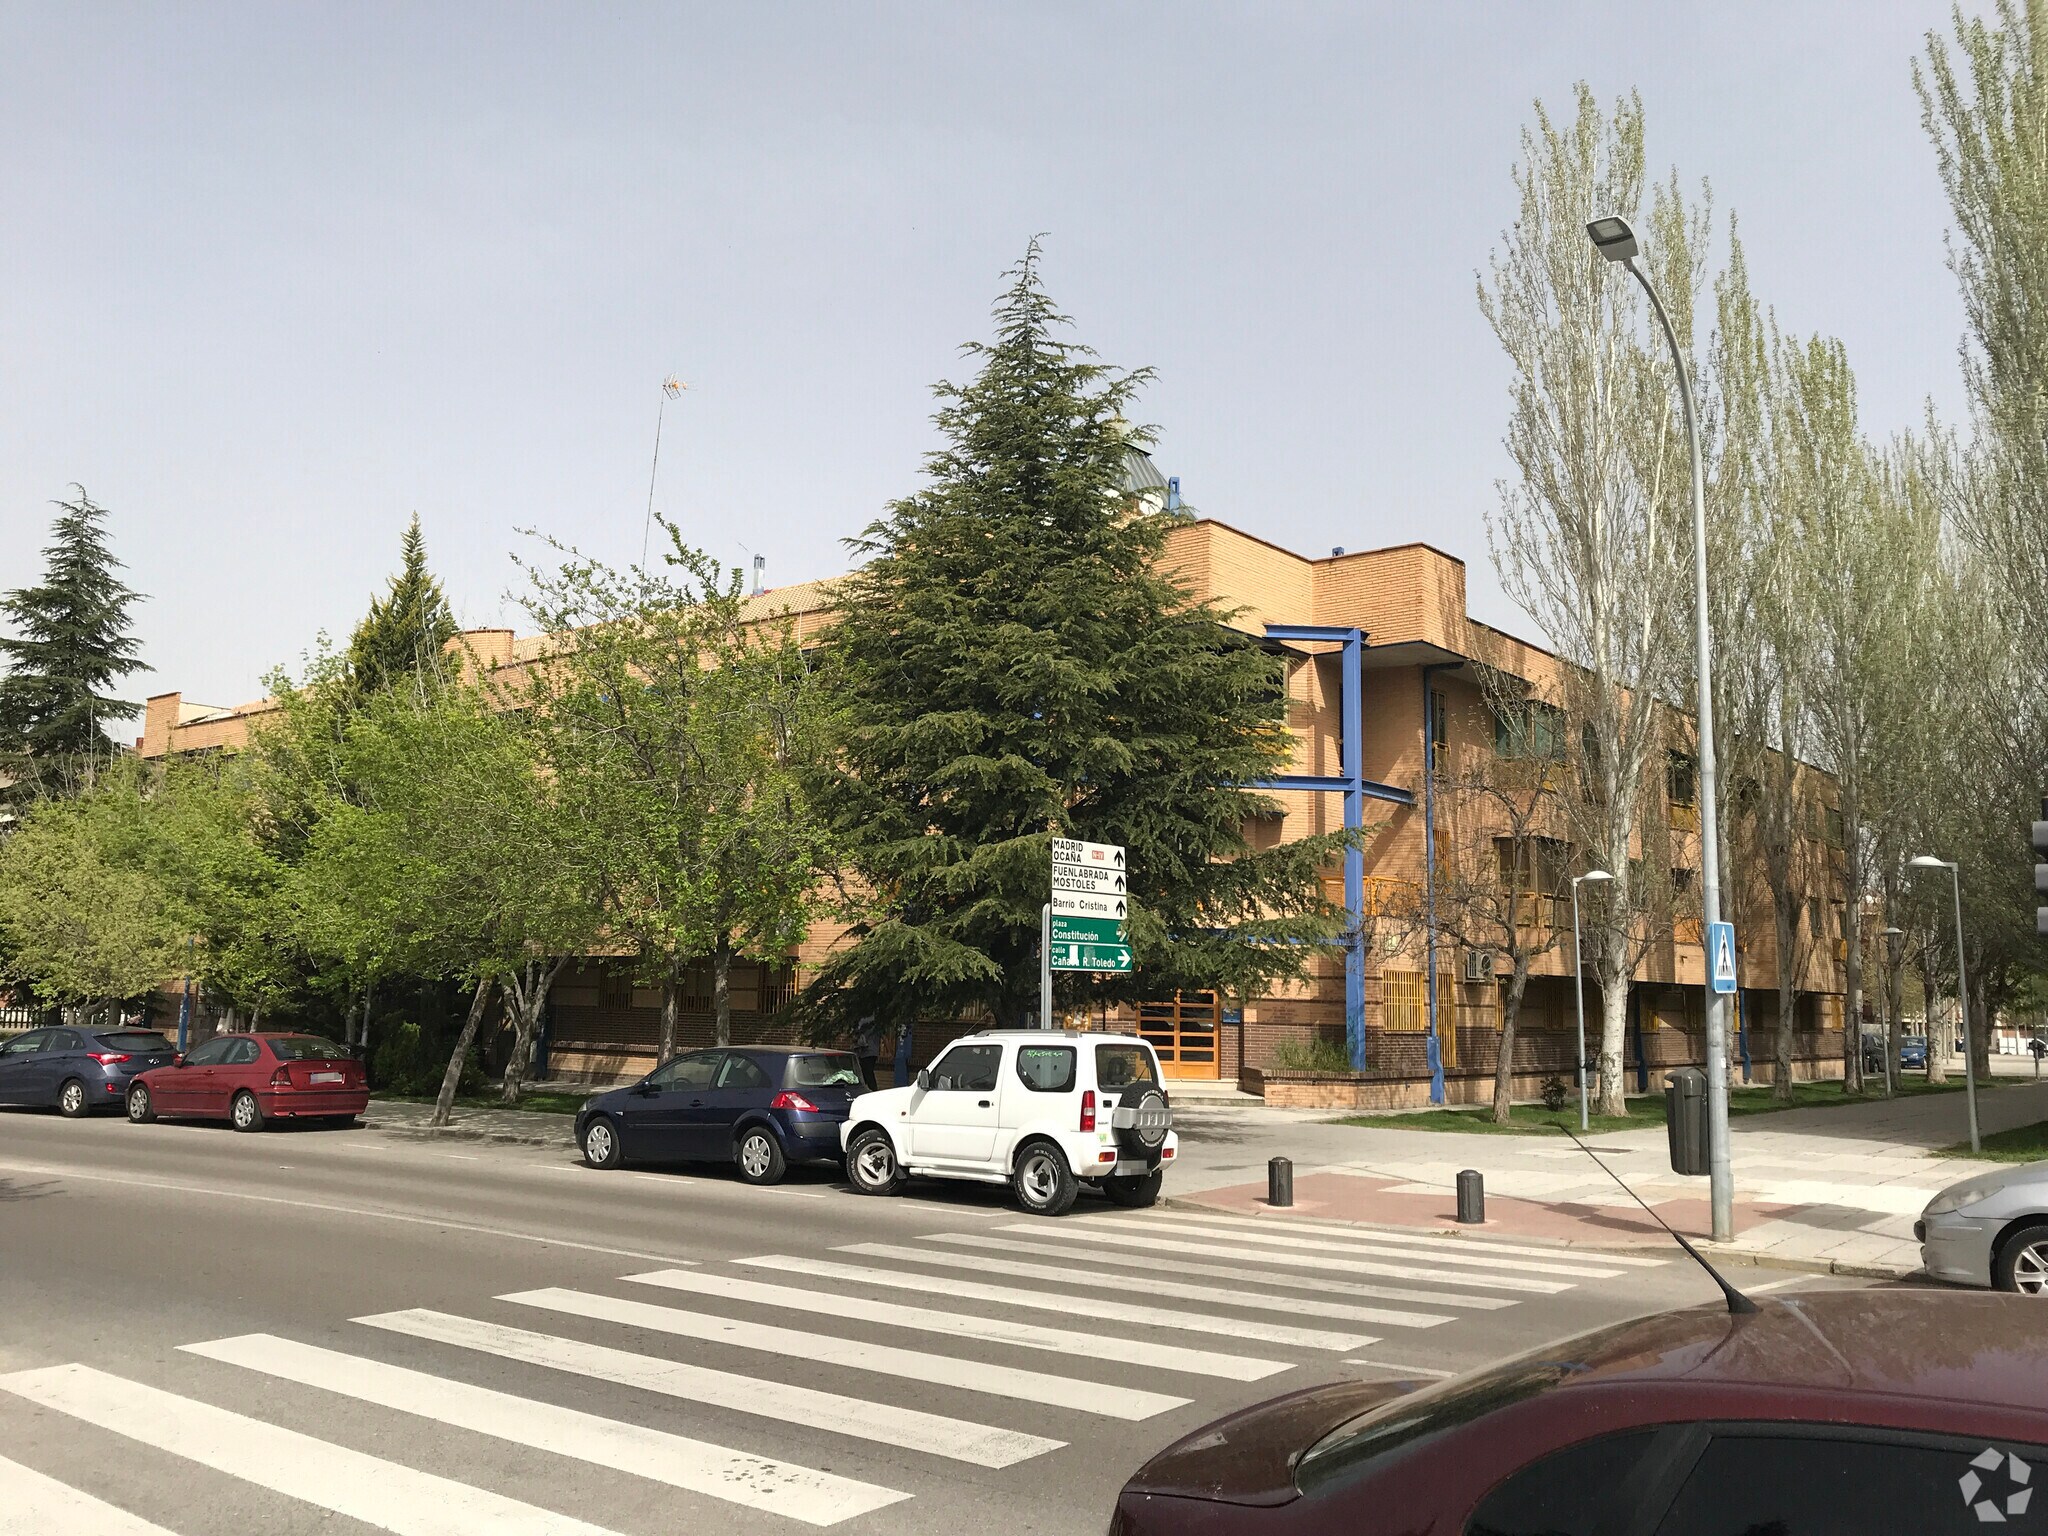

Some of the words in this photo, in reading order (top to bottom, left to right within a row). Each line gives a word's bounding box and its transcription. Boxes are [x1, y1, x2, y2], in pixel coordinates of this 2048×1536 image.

[1053, 839, 1084, 852] MADRID
[1053, 851, 1082, 863] OCAÑA
[1053, 865, 1109, 881] FUENLABRADA
[1053, 876, 1096, 890] MOSTOLES
[1053, 897, 1075, 909] Barrio
[1080, 900, 1108, 912] Cristina
[1052, 920, 1068, 928] plaza
[1052, 929, 1099, 941] Constitución
[1051, 946, 1066, 954] calle
[1091, 957, 1116, 968] Toledo
